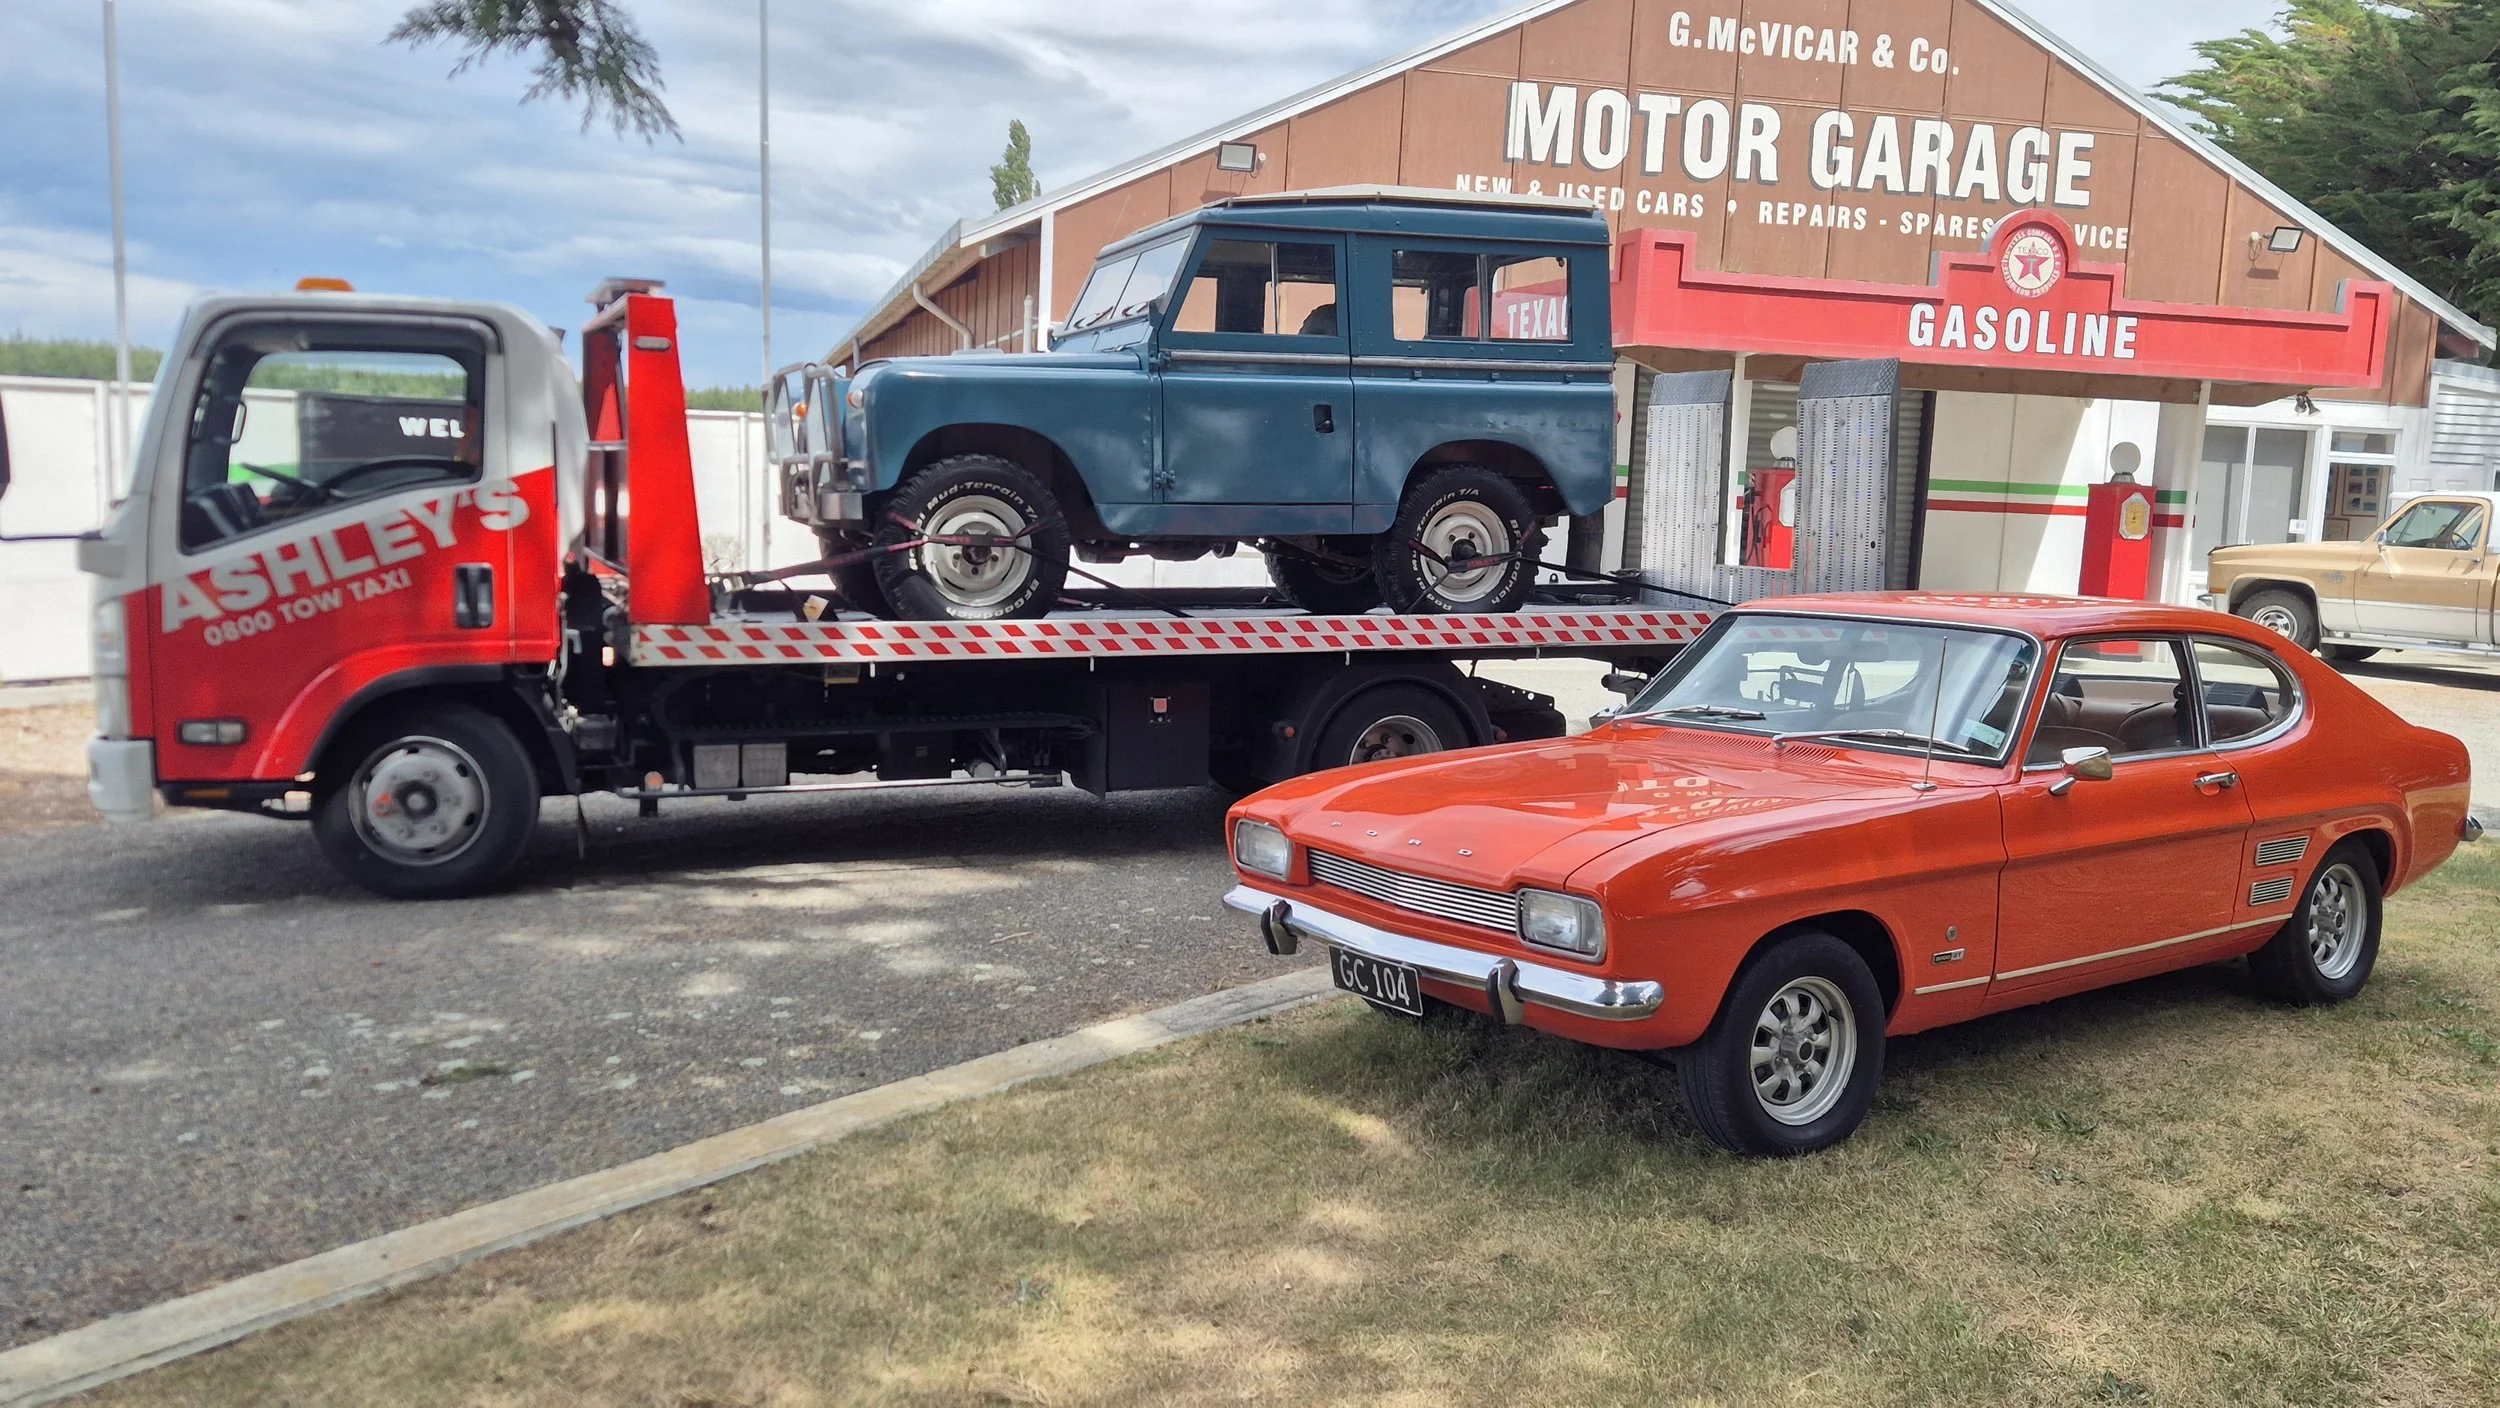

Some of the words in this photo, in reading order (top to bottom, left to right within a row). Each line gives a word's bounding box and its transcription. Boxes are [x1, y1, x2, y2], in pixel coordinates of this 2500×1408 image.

[1871, 33, 1895, 69] &
[1908, 37, 1960, 76] Co.
[1505, 81, 1782, 186] MOTOR
[1808, 110, 2096, 208] GARAGE
[1456, 174, 1512, 194] NEW
[1527, 180, 1543, 197] &
[1558, 182, 1625, 211] USED
[1637, 189, 1704, 218] CARS
[1758, 201, 1867, 231] REPAIRS
[1899, 211, 1994, 240] SPARES
[2074, 223, 2128, 250] VICE
[2017, 246, 2049, 256] TEXACO
[1508, 295, 1568, 339] TEXAC
[1908, 302, 2138, 359] GASOLINE
[398, 416, 465, 438] WEL
[160, 478, 530, 634] ASHLEY'S
[203, 611, 276, 647] 0800
[278, 587, 344, 624] TOW
[346, 567, 413, 601] TAXI
[945, 578, 1040, 620] BFGoodrich
[1330, 820, 1473, 857] FORD
[1339, 954, 1369, 992] GC
[1371, 963, 1411, 1007] 104
